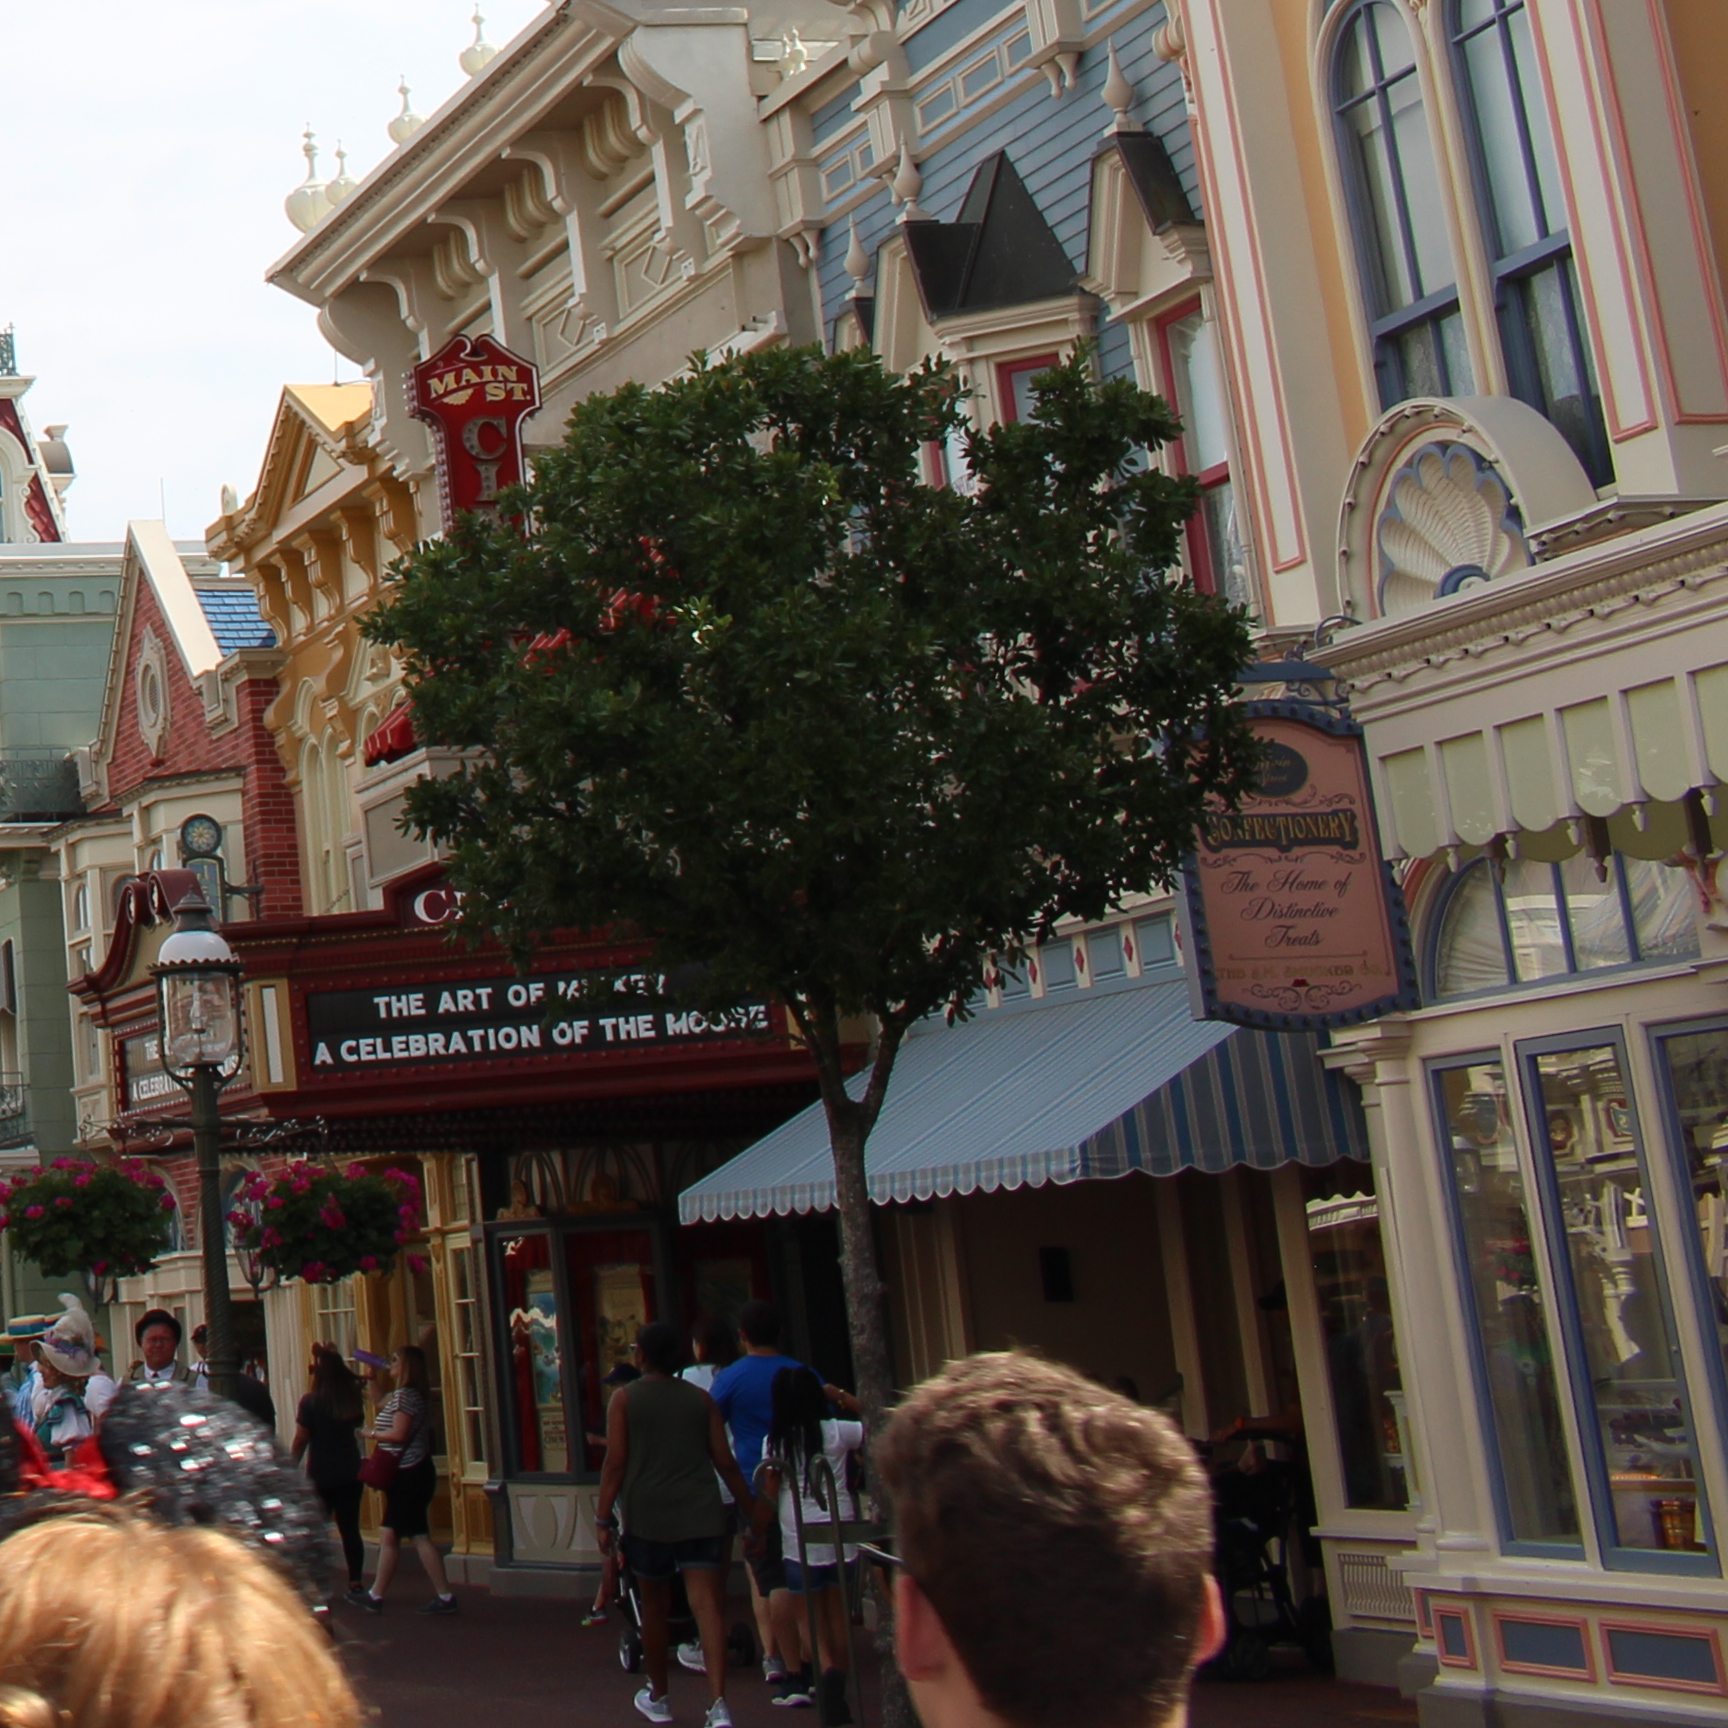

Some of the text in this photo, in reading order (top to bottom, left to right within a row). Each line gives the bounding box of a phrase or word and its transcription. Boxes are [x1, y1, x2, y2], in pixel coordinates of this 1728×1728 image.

[427, 365, 519, 399] MAIN
[484, 382, 531, 402] ST.
[1221, 869, 1352, 898] The Home of
[1240, 896, 1339, 921] Distinctive
[1264, 924, 1322, 949] Treats
[373, 992, 426, 1019] THE
[437, 987, 493, 1013] ART
[507, 982, 546, 1009] OF
[313, 1041, 334, 1066] A
[340, 1024, 541, 1063] CELEBRATION
[552, 1019, 591, 1046] OF
[599, 1014, 656, 1042] THE
